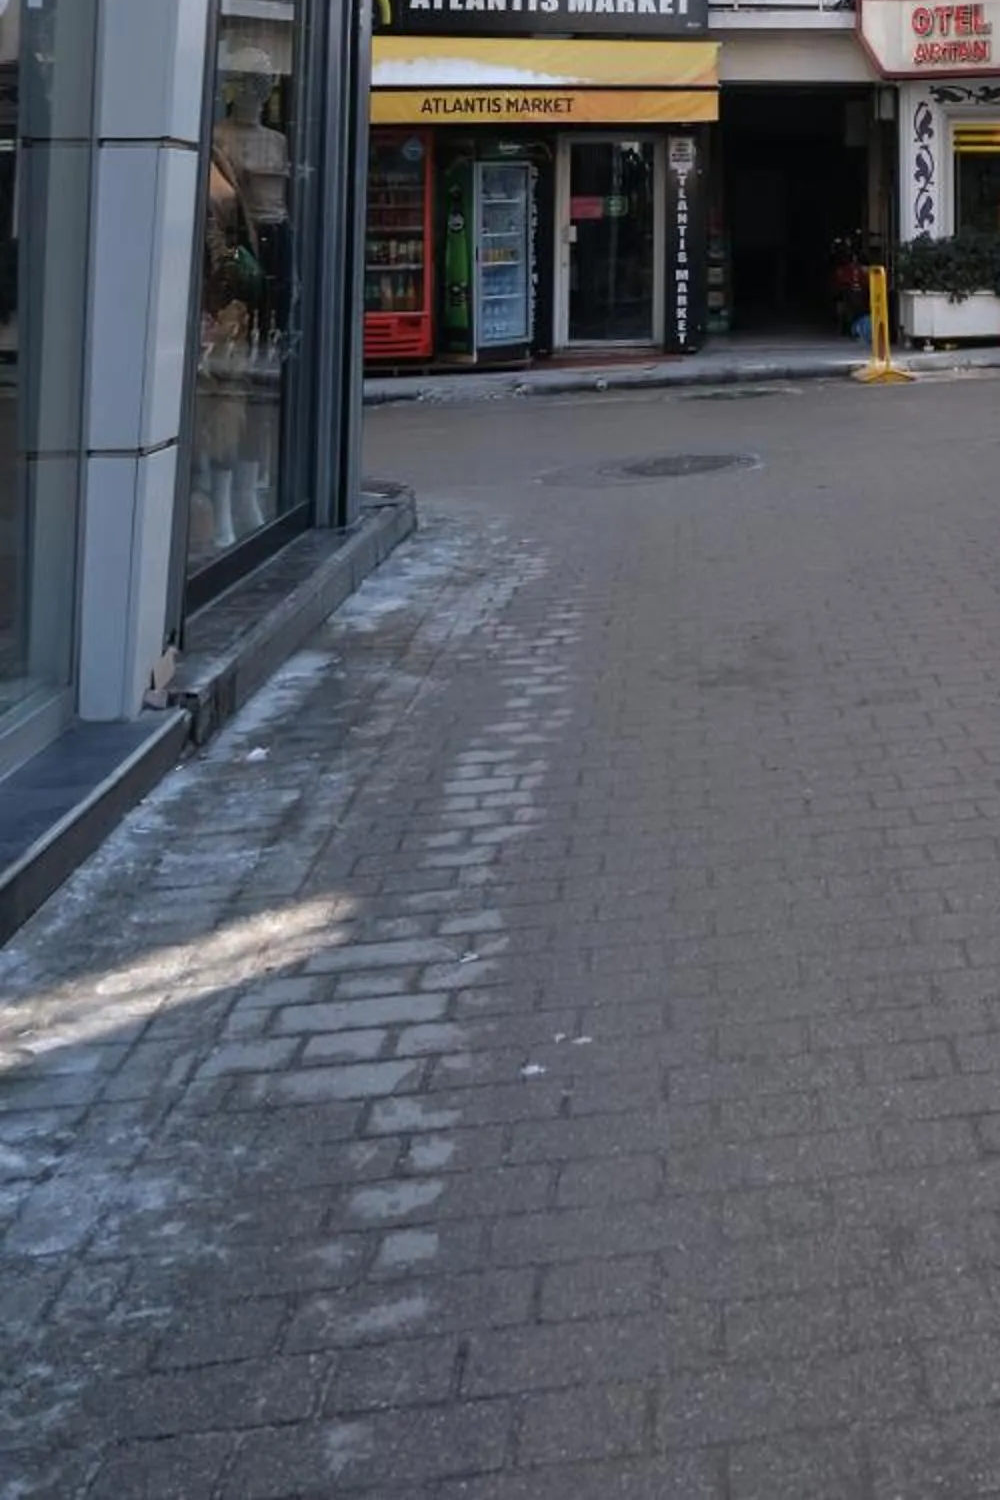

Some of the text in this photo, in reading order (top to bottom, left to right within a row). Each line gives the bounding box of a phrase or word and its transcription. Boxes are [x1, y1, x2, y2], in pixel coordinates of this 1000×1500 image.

[911, 3, 993, 37] OTEL
[912, 40, 991, 65] ARTAN
[421, 97, 575, 114] ATLANTIS MARKET
